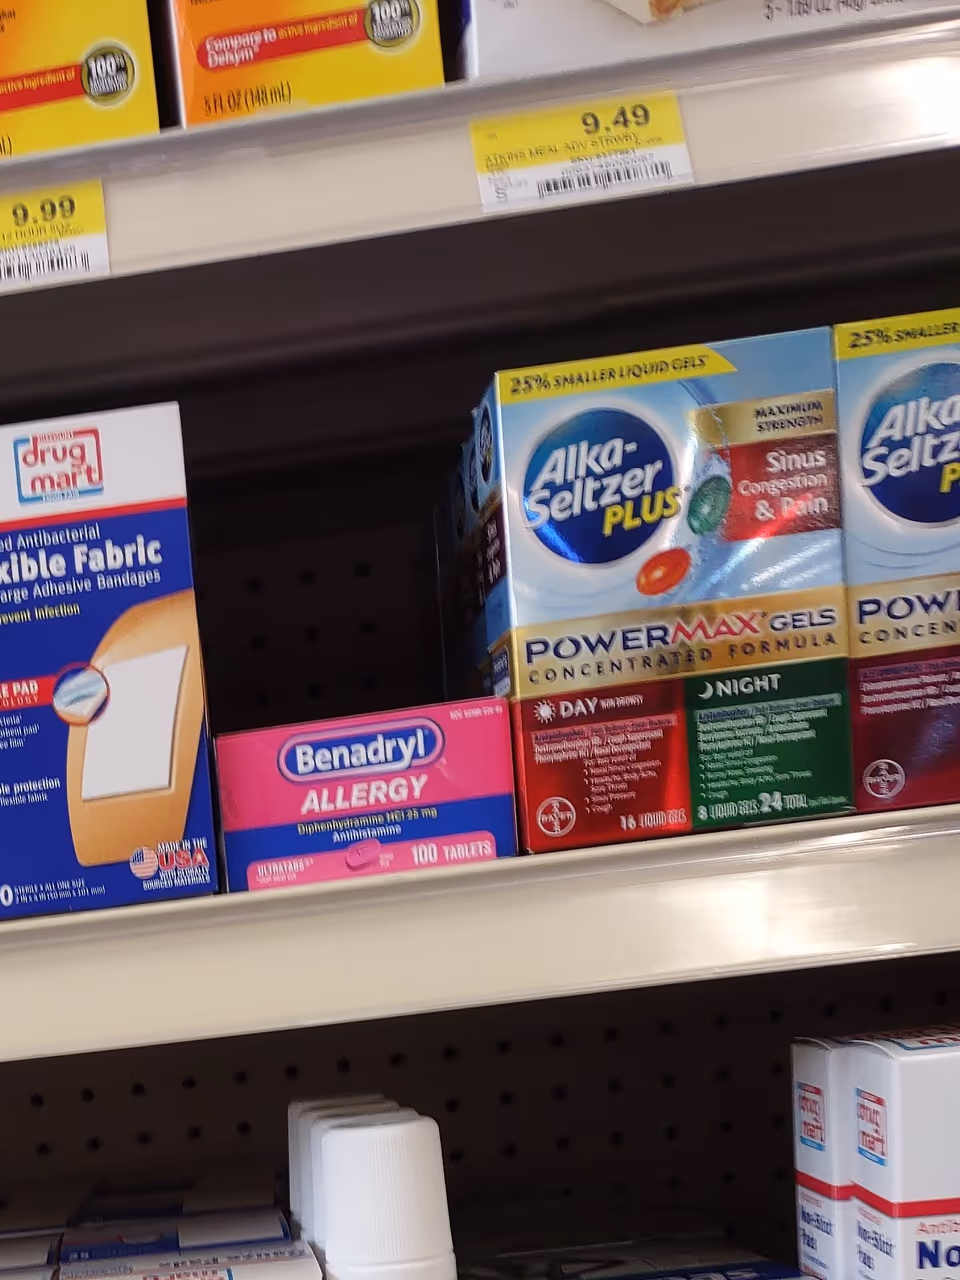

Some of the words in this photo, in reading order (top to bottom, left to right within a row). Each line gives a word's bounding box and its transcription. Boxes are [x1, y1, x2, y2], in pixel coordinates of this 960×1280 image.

[581, 102, 651, 138] 9.49
[11, 195, 76, 227] 9.99
[511, 372, 551, 395] 25%
[552, 366, 616, 389] SMALLER
[619, 359, 669, 381] LIQUID
[672, 355, 709, 373] GELS
[22, 441, 86, 468] drug
[528, 436, 638, 494] Alka-
[765, 450, 827, 474] Sinus
[31, 464, 103, 494] mart
[524, 458, 663, 529] Seltzer
[738, 471, 828, 498] Congestion
[603, 486, 682, 537] PLUS
[755, 501, 774, 521] &
[780, 496, 829, 518] Pain
[74, 534, 162, 574] Fabric
[526, 611, 759, 665] POWERMAX
[769, 607, 837, 632] GELS
[529, 647, 713, 685] CONCENTRATED
[728, 632, 837, 659] FORMULA
[715, 673, 781, 699] NIGHT
[559, 699, 598, 719] DAY
[296, 729, 426, 775] Benadryl
[300, 774, 428, 815] ALLERGY
[410, 843, 437, 865] 100
[442, 841, 492, 861] TABLETS
